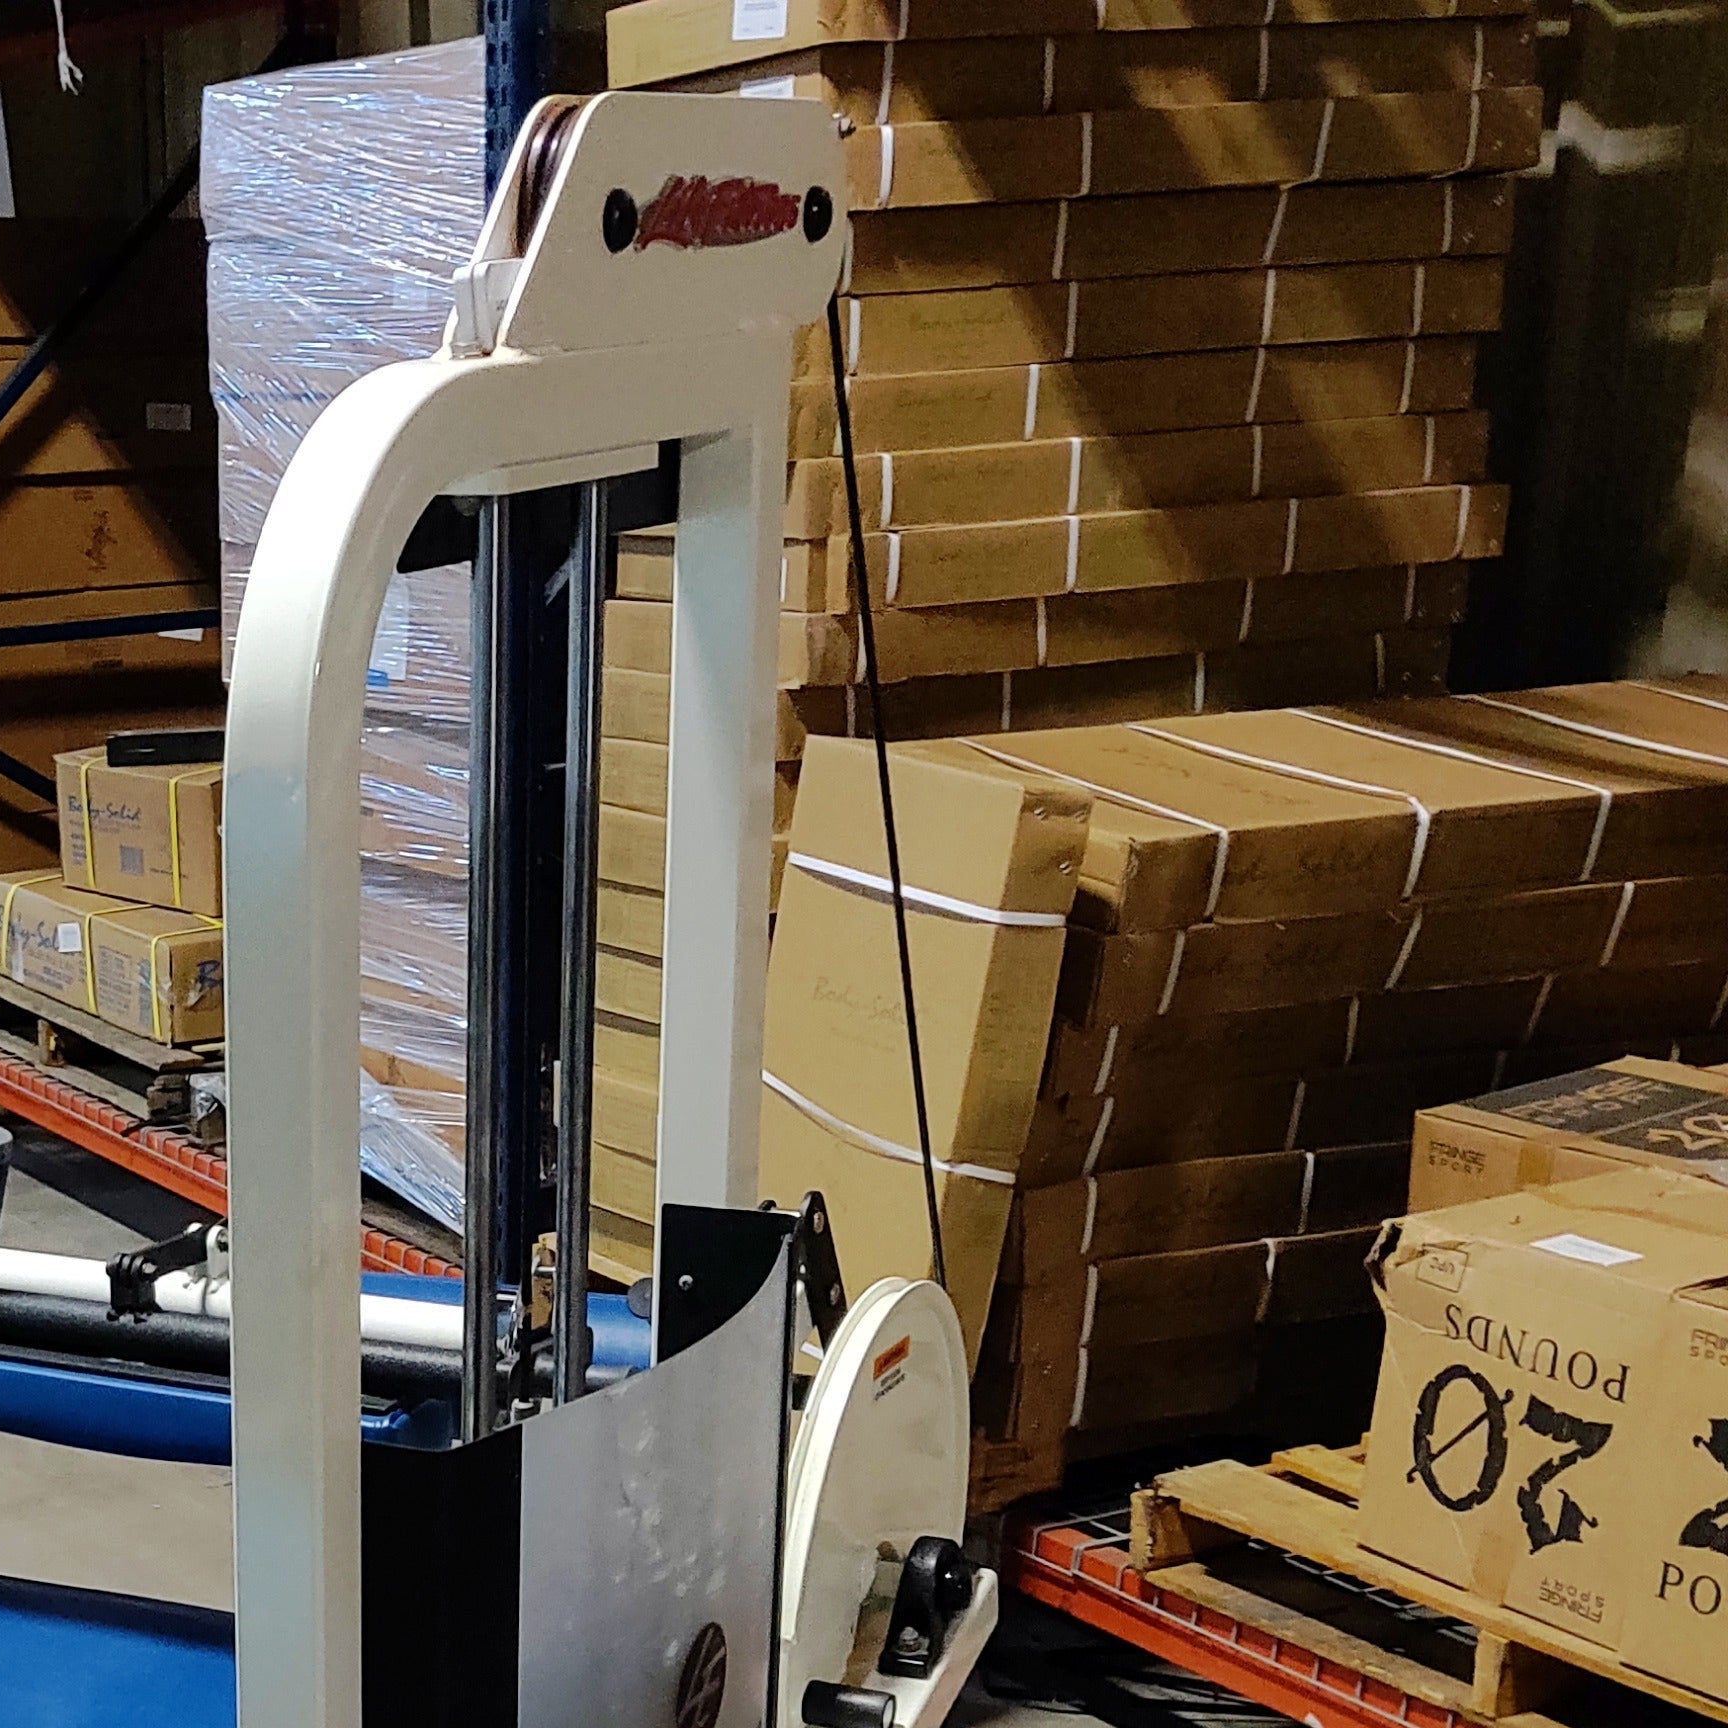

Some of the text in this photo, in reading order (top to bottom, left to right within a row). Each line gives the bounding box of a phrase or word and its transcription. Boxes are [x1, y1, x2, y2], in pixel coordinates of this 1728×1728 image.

[68, 796, 141, 821] Boy-Solid
[1443, 1303, 1632, 1404] POUNDS
[1538, 1585, 1603, 1624] FRINGE
[1540, 1576, 1605, 1609] SPORT
